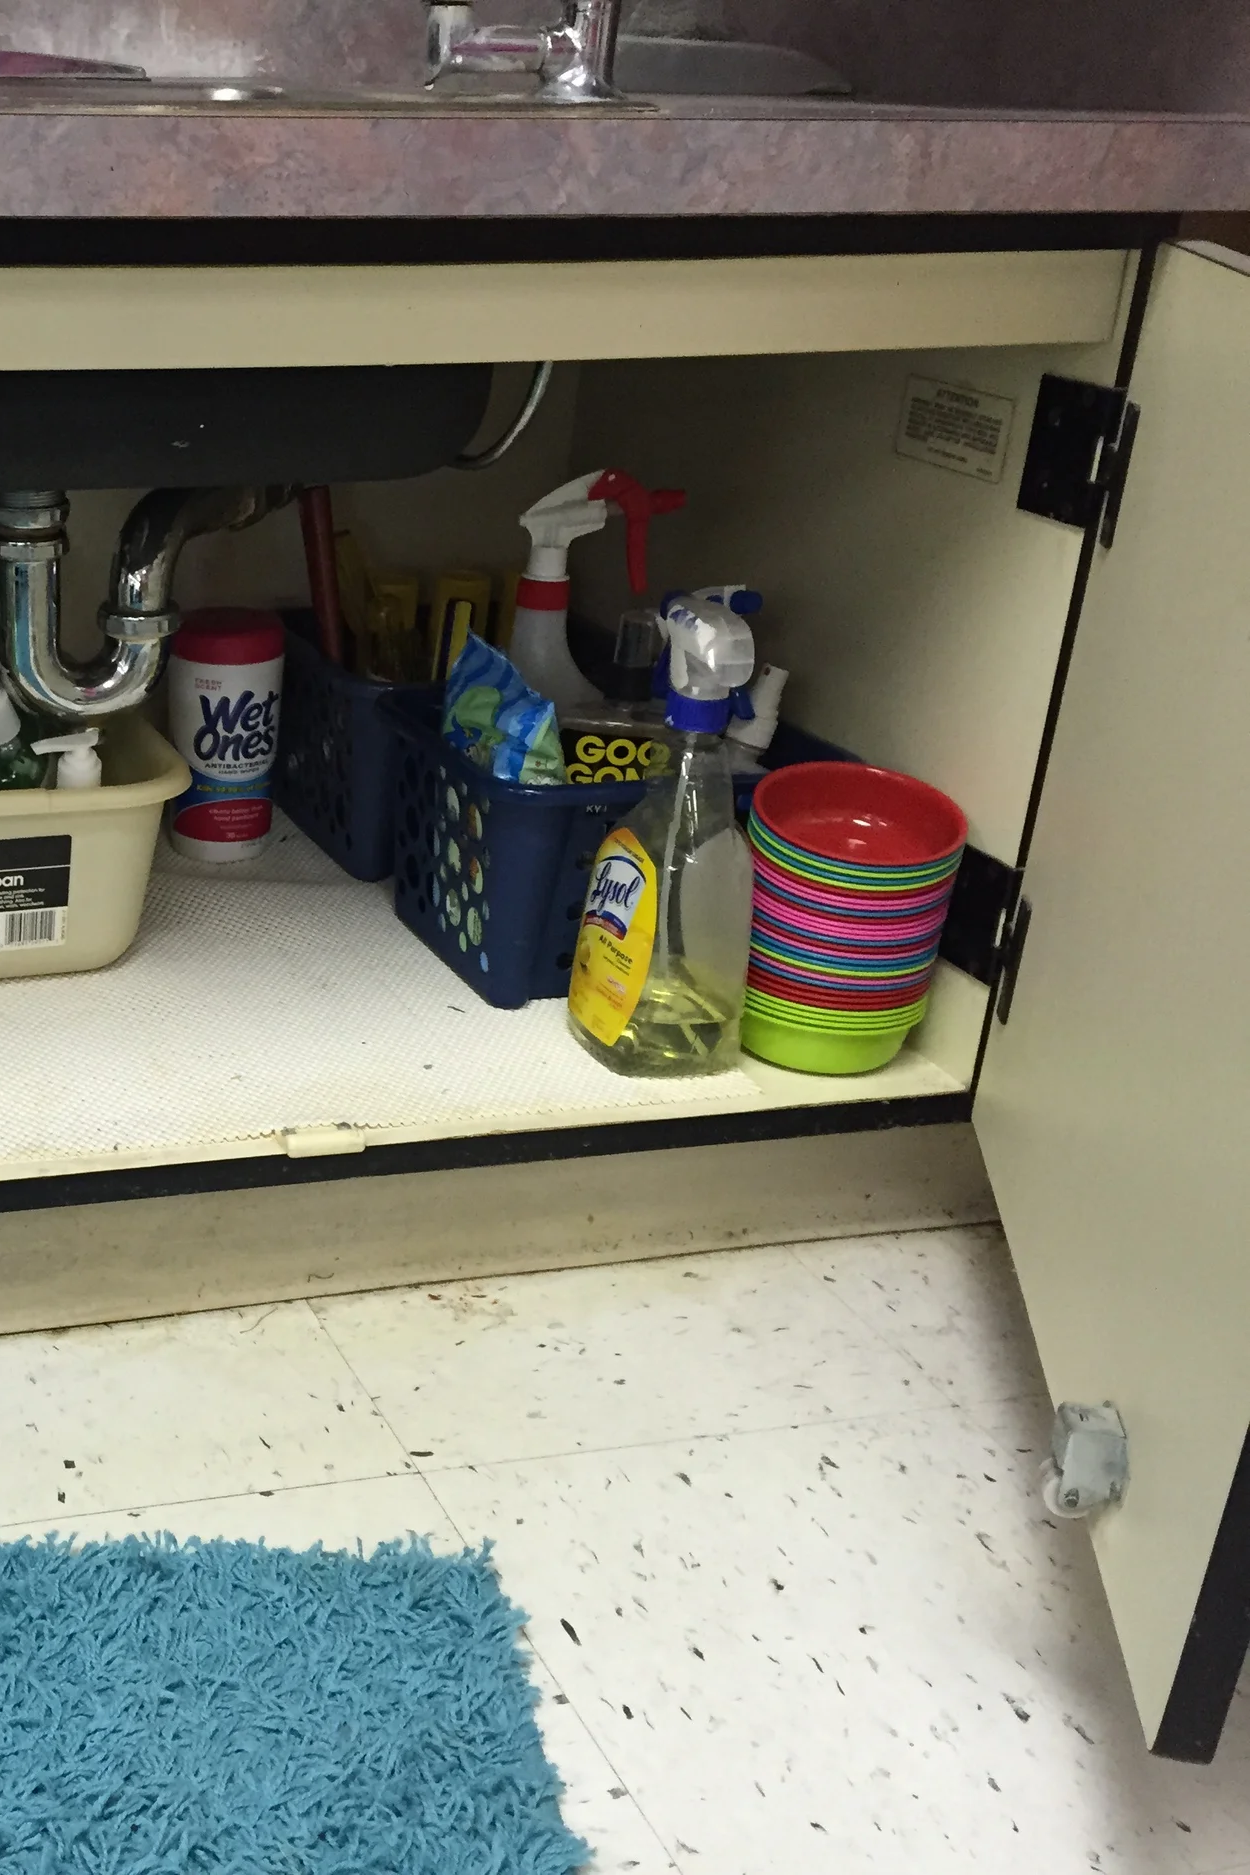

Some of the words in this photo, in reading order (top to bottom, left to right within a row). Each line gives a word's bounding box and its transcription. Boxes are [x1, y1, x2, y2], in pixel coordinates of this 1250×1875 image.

[199, 690, 279, 734] Wet
[193, 724, 275, 761] Ones
[575, 735, 670, 766] GOO
[565, 763, 648, 784] GO
[591, 861, 640, 913] Lysol
[599, 935, 607, 945] All
[607, 940, 633, 964] Purpose
